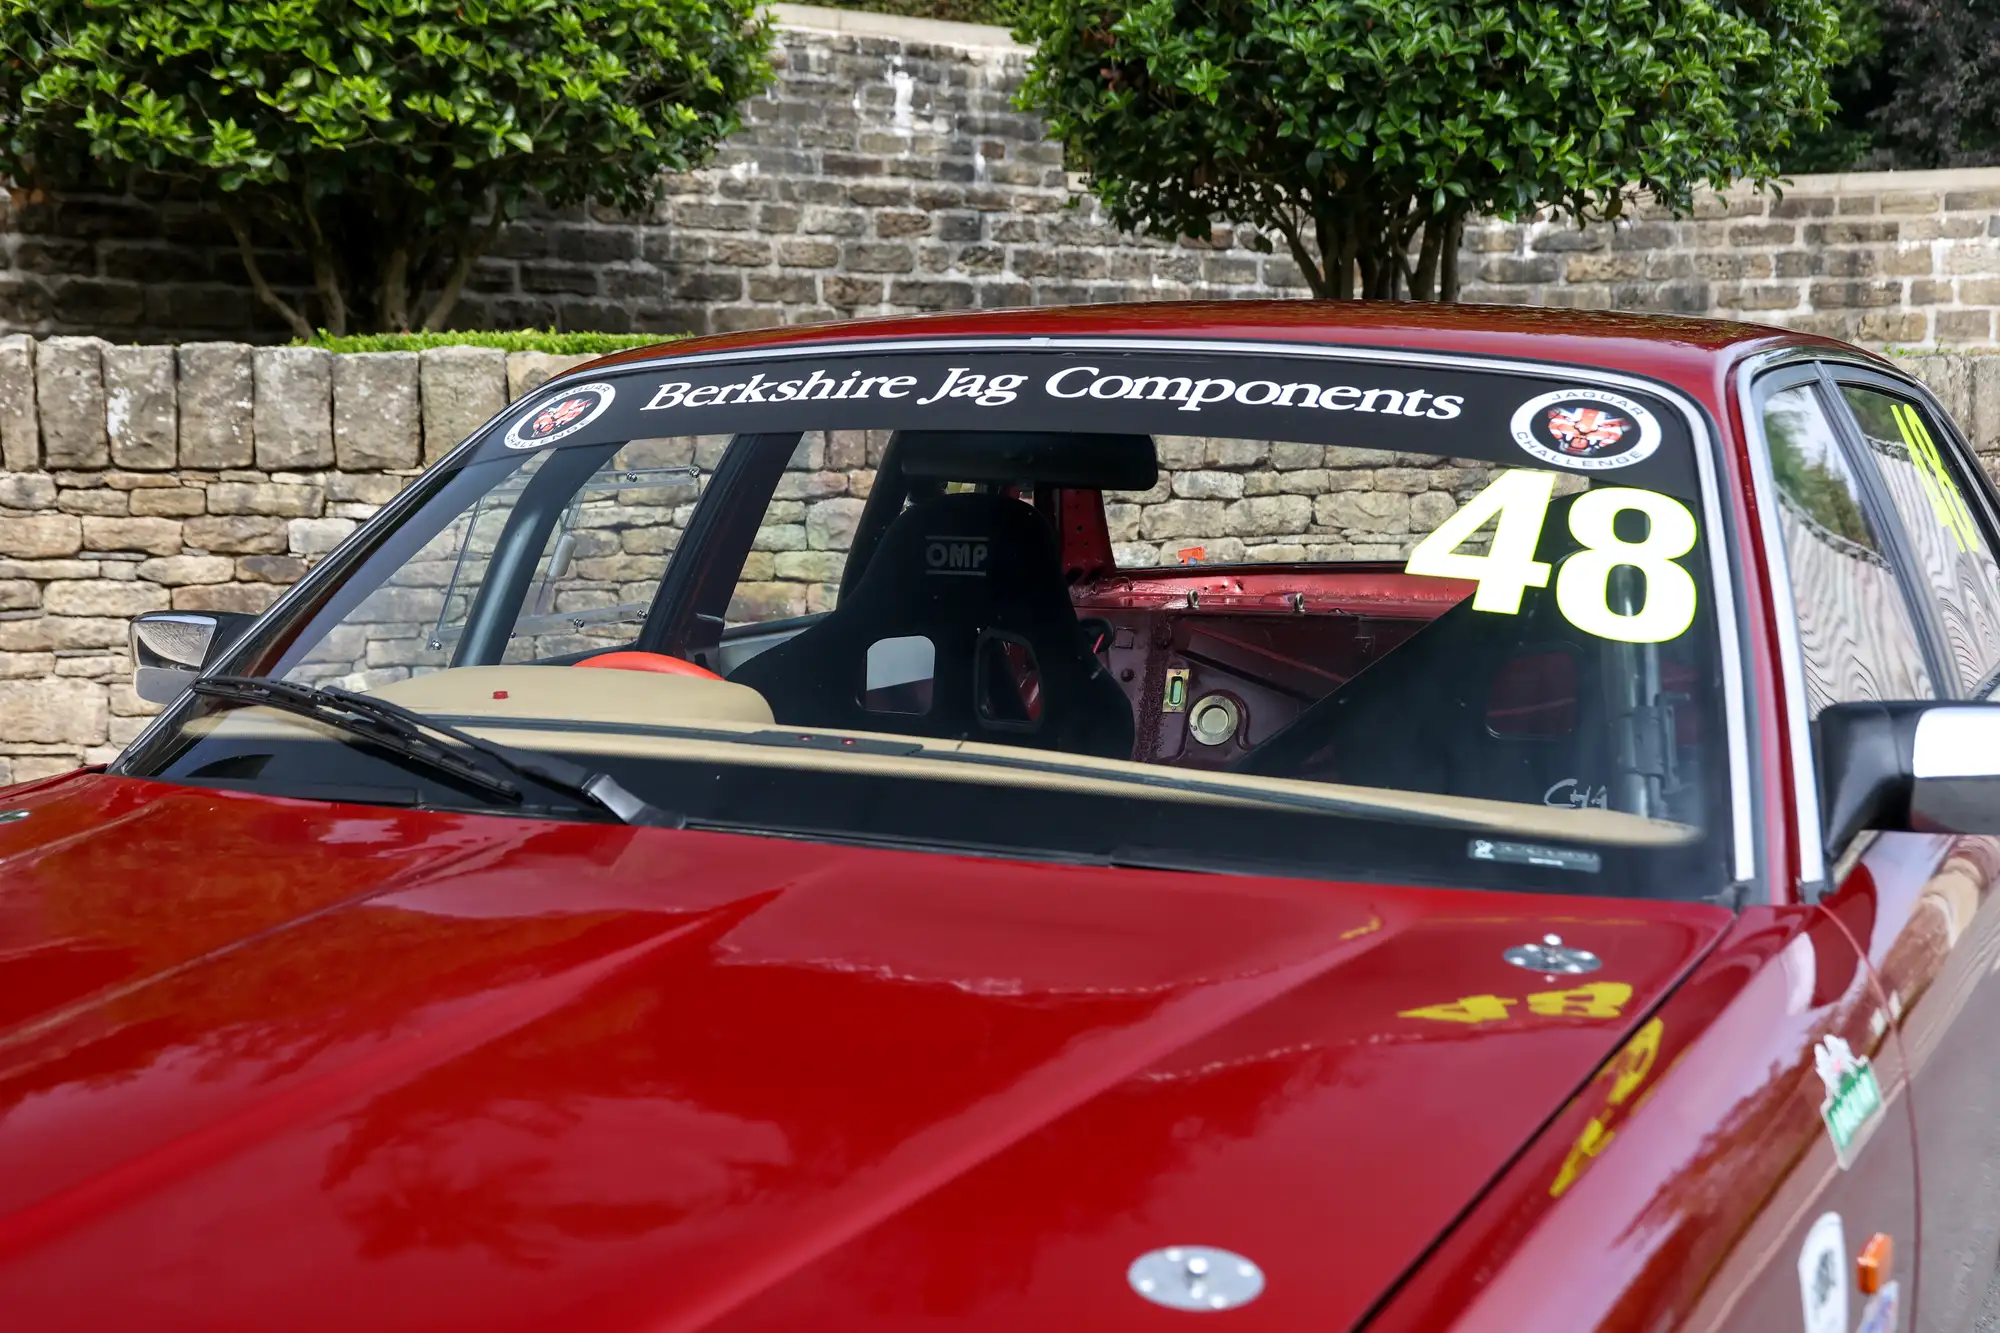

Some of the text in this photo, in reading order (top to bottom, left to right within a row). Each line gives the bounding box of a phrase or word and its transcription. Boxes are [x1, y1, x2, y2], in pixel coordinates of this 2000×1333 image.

[639, 366, 1465, 420] Berkshire Jag Components
[1551, 390, 1644, 415] JAGUAR
[1516, 430, 1643, 467] CHALLENGE
[925, 542, 988, 568] OMP
[1404, 468, 1698, 643] 48
